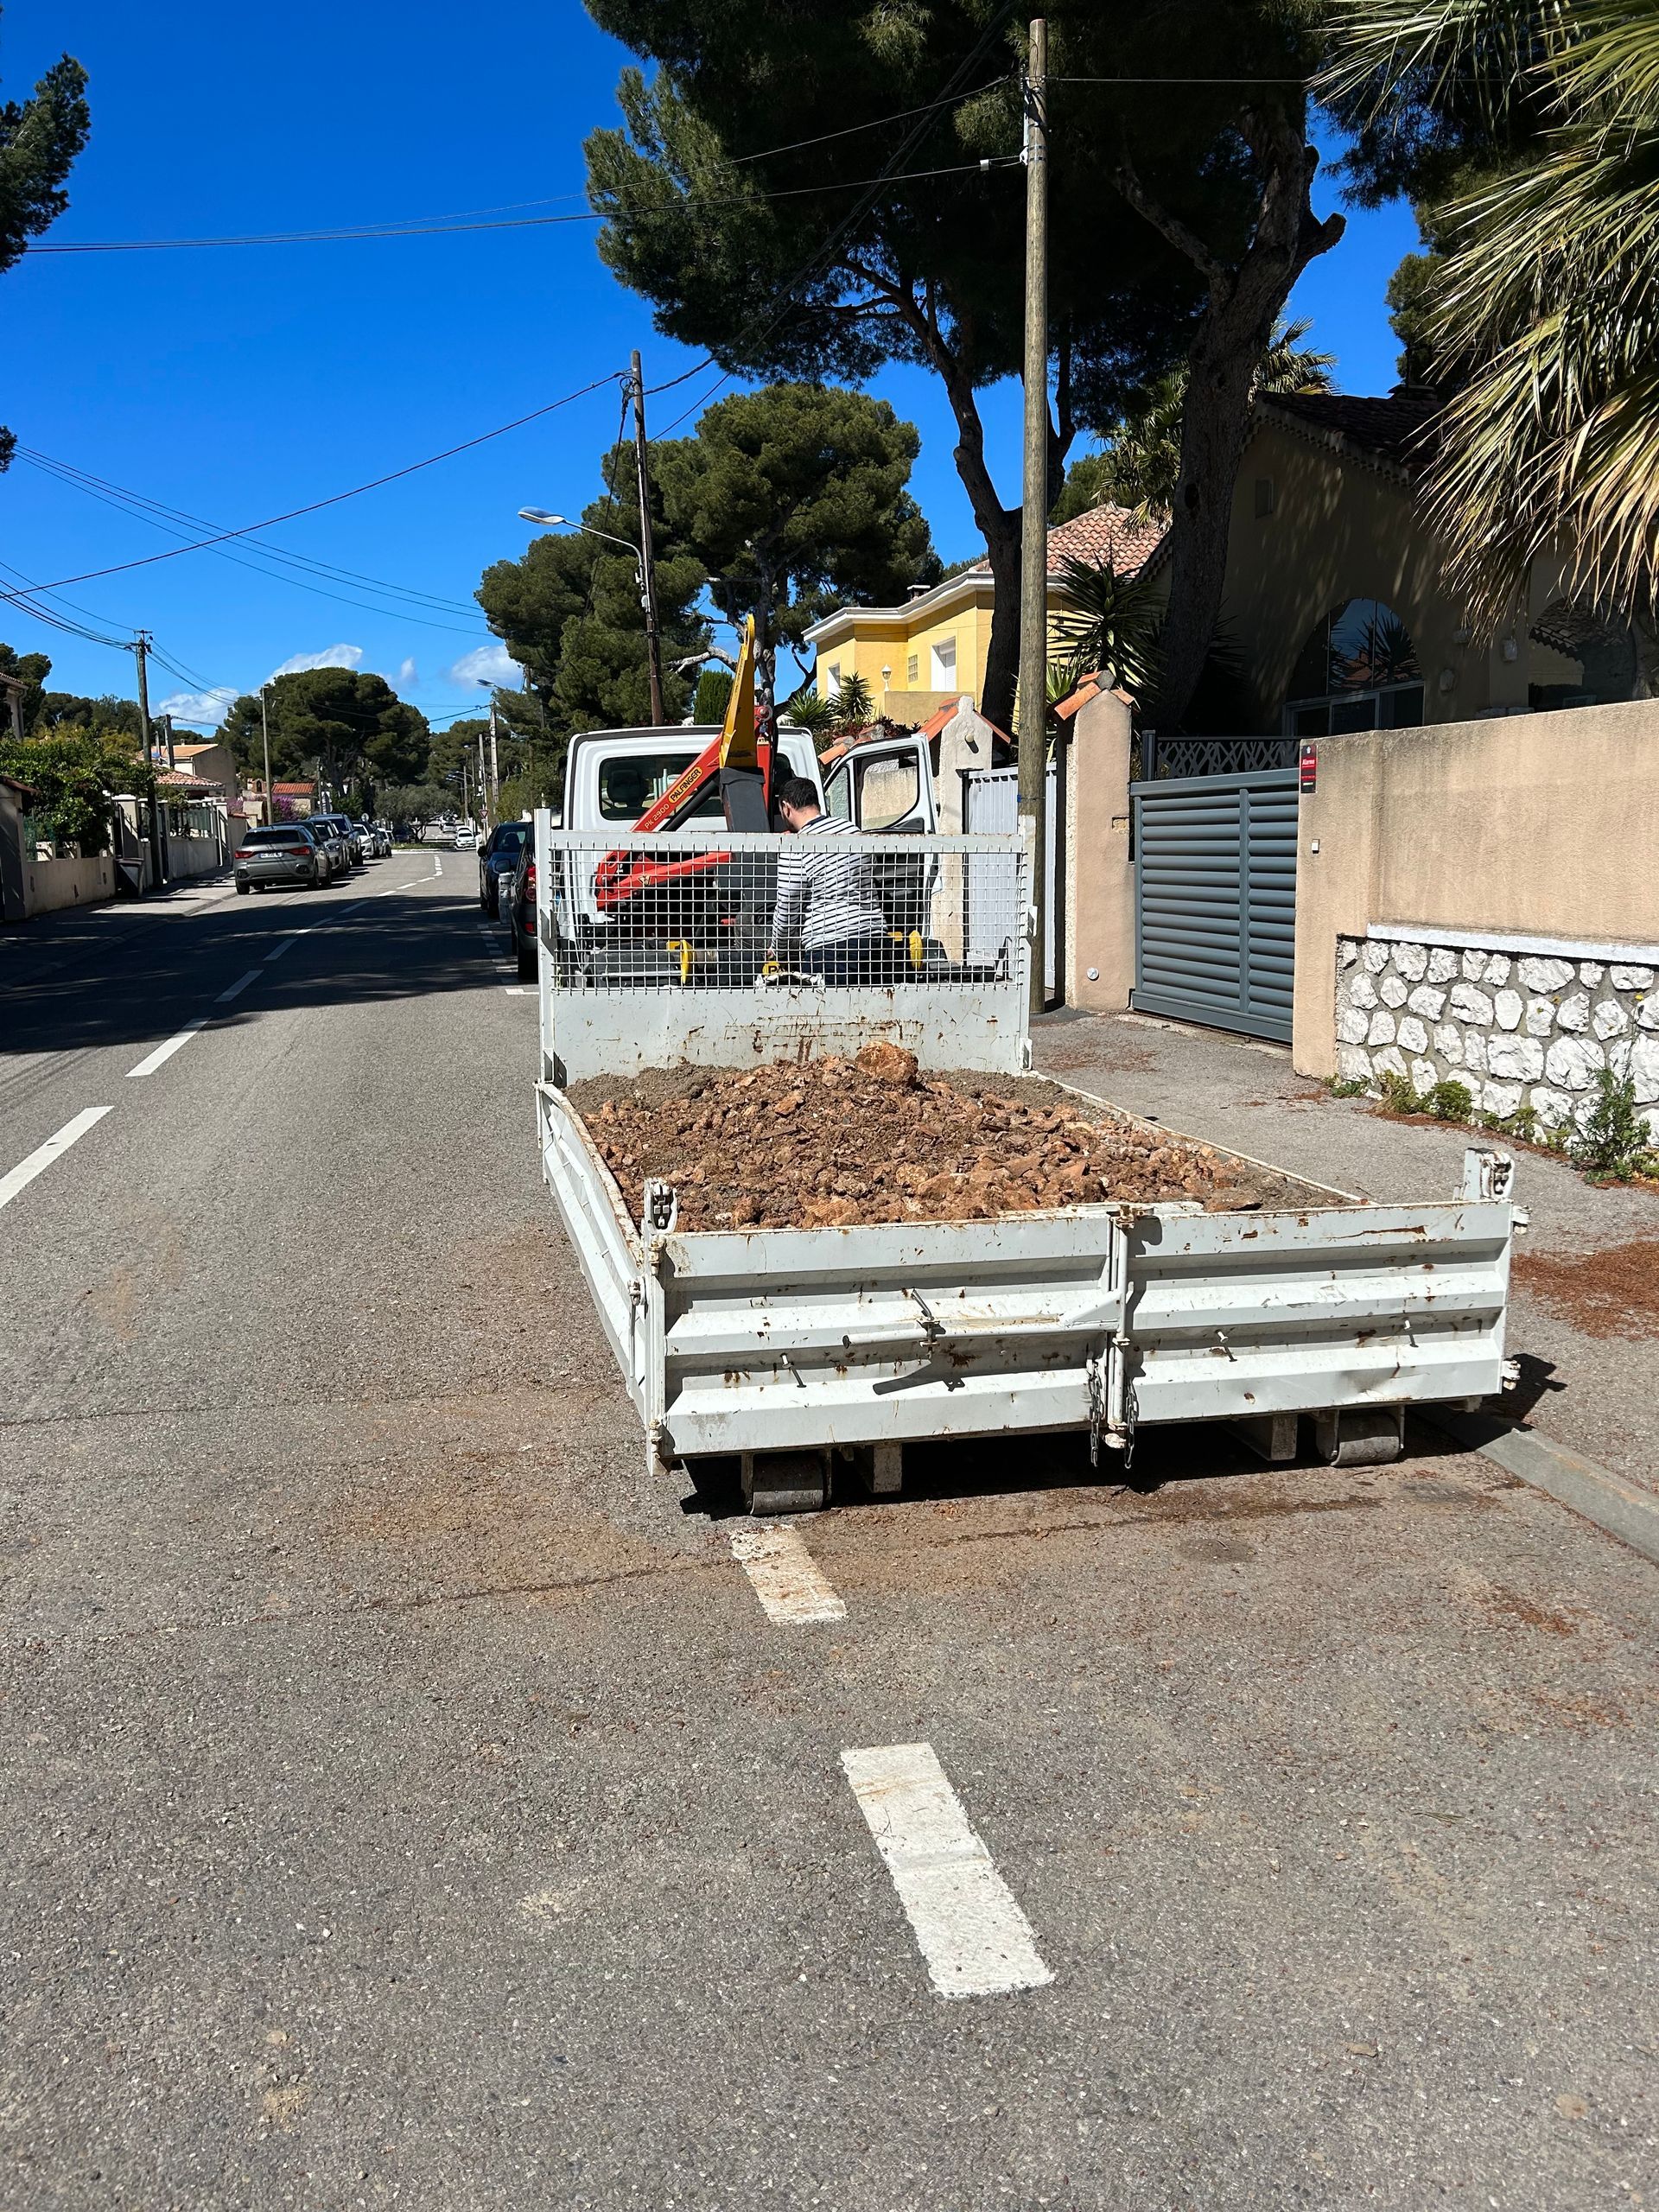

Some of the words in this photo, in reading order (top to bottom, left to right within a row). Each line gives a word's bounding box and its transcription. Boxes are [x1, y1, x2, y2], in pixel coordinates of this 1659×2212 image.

[671, 769, 701, 801] PALFINGER
[644, 819, 654, 829] PK
[652, 804, 670, 821] 2900
